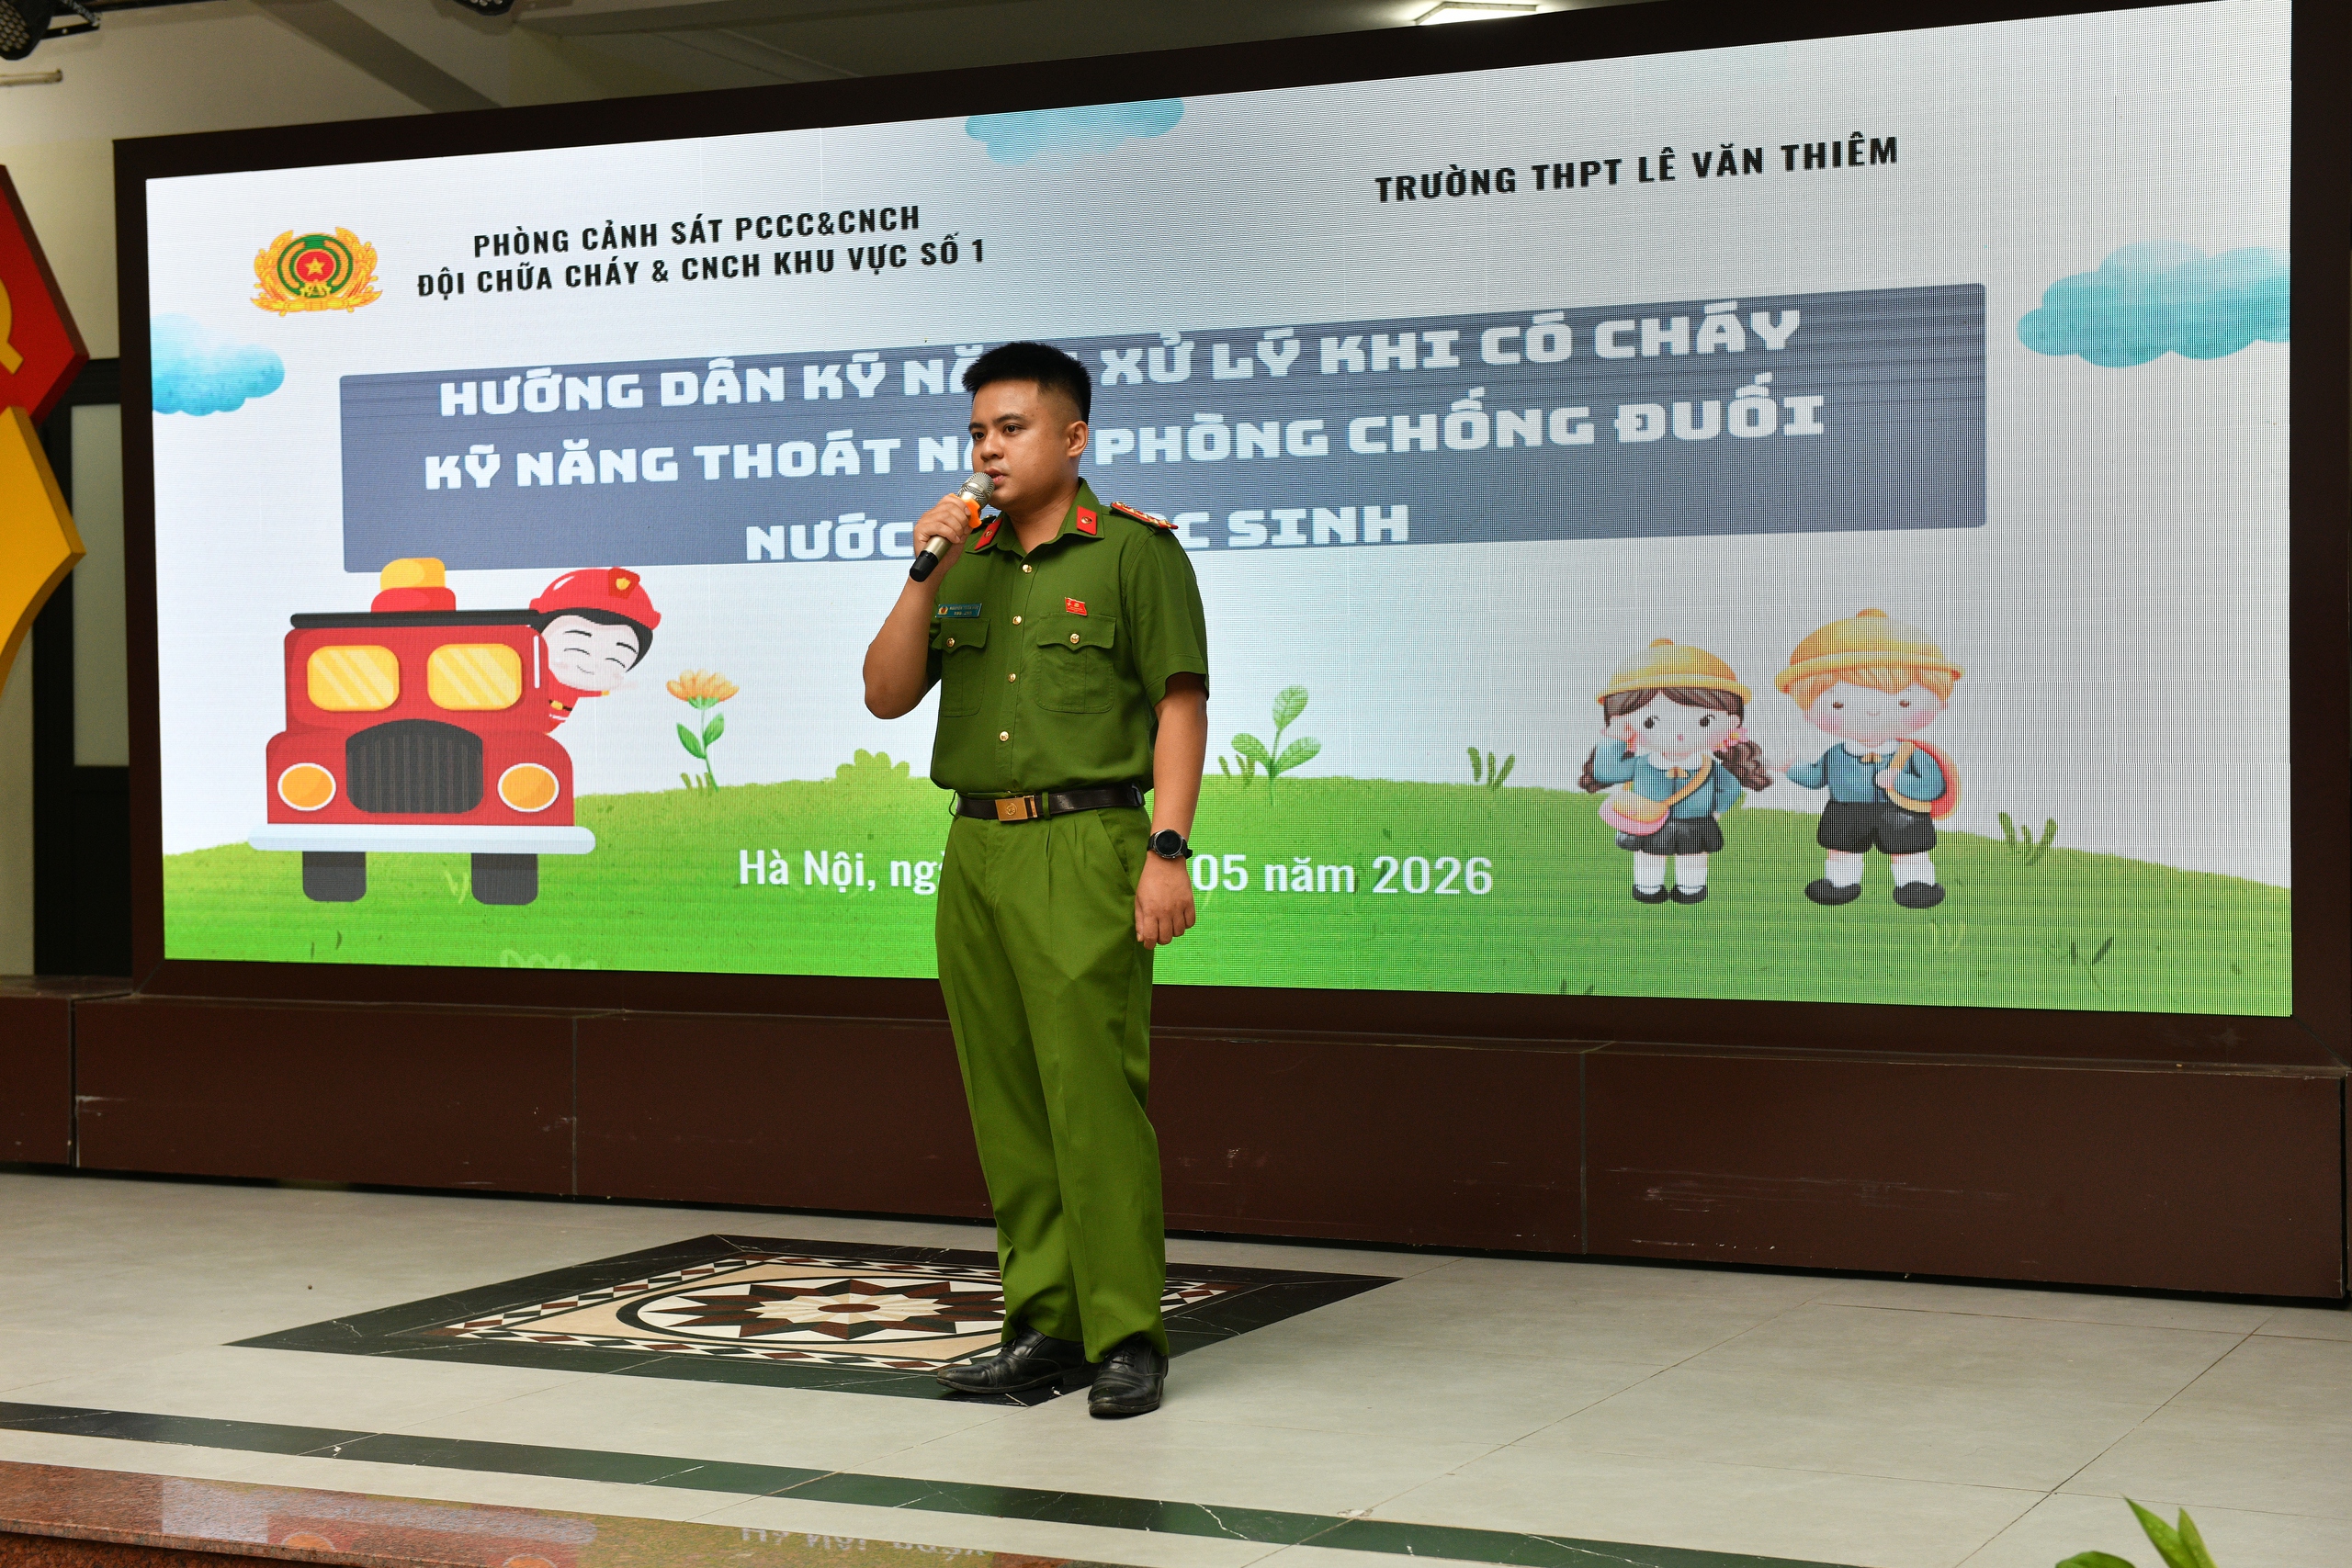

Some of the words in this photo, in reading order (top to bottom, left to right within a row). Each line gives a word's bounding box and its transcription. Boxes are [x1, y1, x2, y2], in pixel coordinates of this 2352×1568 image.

[1375, 164, 1516, 203] TRƯỜNG
[1532, 158, 1623, 191] THPT
[1638, 146, 1675, 182] LÊ
[1691, 143, 1762, 178] VĂN
[1781, 131, 1897, 172] THIÊM
[417, 266, 465, 300] ĐỘI
[478, 262, 552, 292] CHỮA
[565, 256, 639, 288] CHÁY
[651, 260, 668, 282] &
[682, 254, 761, 281] CNCH
[775, 249, 835, 275] KHU
[848, 243, 908, 276] VỰC
[921, 231, 960, 265] SỐ
[971, 239, 984, 263] 1
[474, 226, 569, 258] PHÒNG
[582, 220, 658, 251] CẢNH
[671, 213, 723, 244] SÁT
[736, 205, 920, 241] PCCC&CNCH
[441, 367, 643, 417] HƯỚNG
[804, 352, 887, 400] KỸ
[1101, 332, 1195, 386] XỬ
[1212, 327, 1301, 381] LÝ
[1320, 330, 1460, 375] KHI
[1480, 310, 1573, 366] CÓ
[1594, 301, 1801, 359] CHÁY
[424, 444, 501, 490] KỸ
[516, 438, 679, 487] NĂNG
[693, 429, 901, 480] THOÁT
[1095, 413, 1329, 465] PHÒNG
[1349, 387, 1595, 455] CHỐNG
[1614, 372, 1825, 443] ĐUỐI
[746, 513, 915, 561] NƯỚC
[1227, 505, 1408, 547] SINH
[739, 849, 790, 885] Hà
[804, 851, 876, 894] Nội,
[889, 851, 944, 896] ng
[1193, 854, 1249, 891] 05
[1264, 857, 1356, 893] năm
[1372, 856, 1494, 896] 2026
